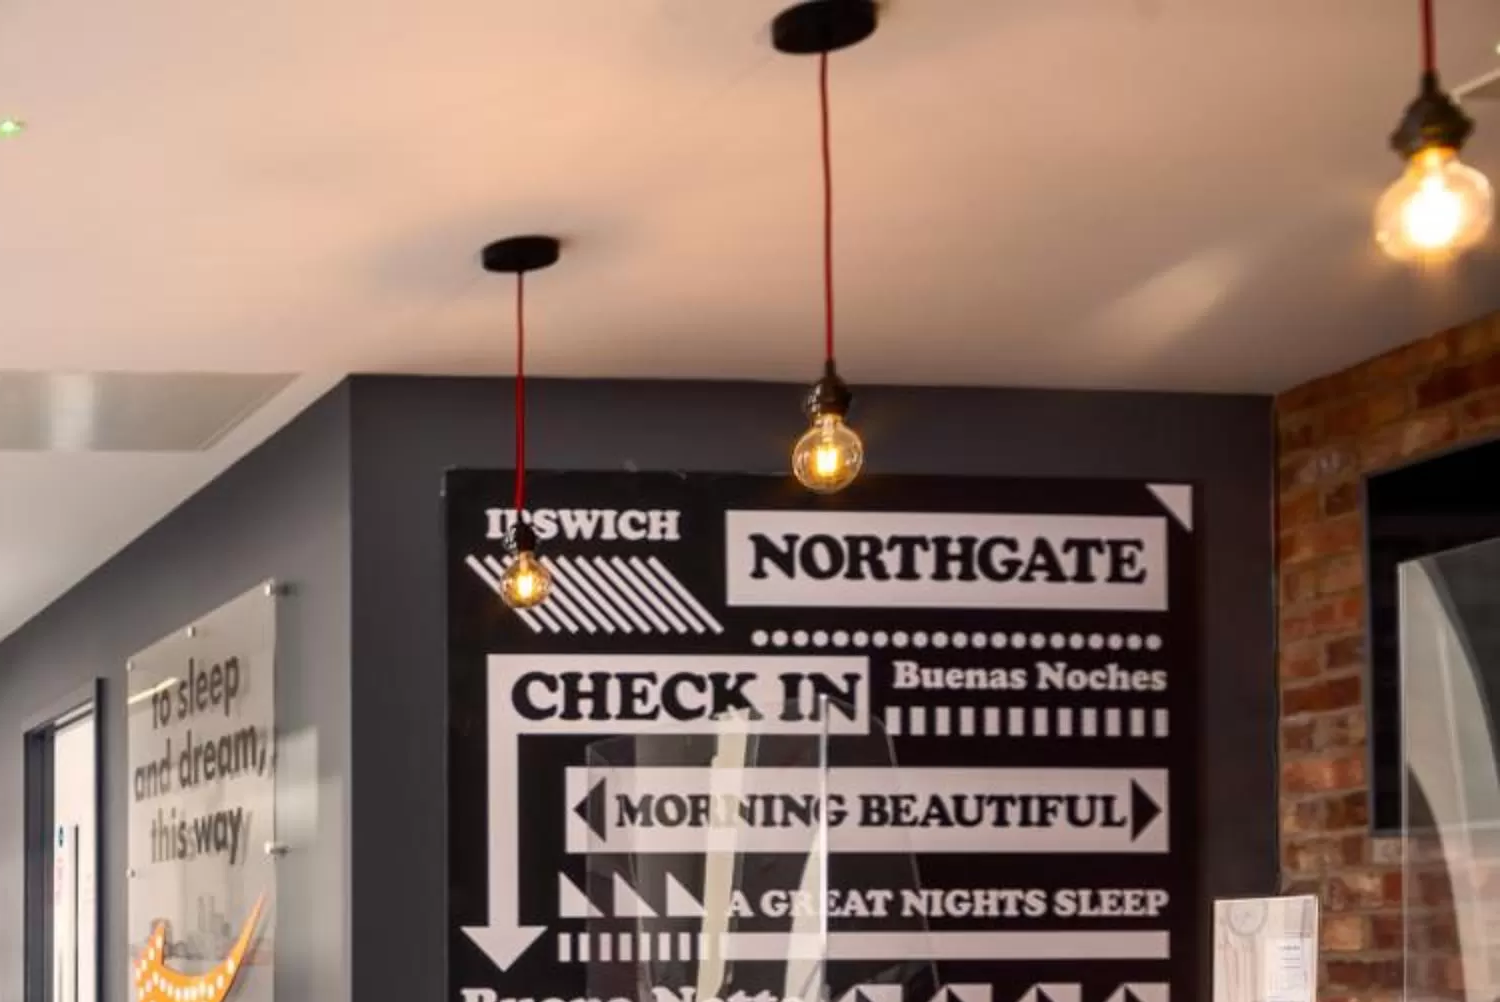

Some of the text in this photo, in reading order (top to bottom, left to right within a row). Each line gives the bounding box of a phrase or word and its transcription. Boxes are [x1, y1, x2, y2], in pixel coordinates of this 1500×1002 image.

[748, 533, 1148, 584] NORTHGATE
[177, 655, 240, 721] sleep
[510, 671, 862, 722] CHECK IN
[892, 659, 1168, 692] Buenas Noches
[134, 737, 171, 803] and
[150, 806, 244, 867] this way
[857, 793, 1128, 829] BEAUTIFUL
[727, 888, 1170, 918] A GREAT NIGHTS SLEEP
